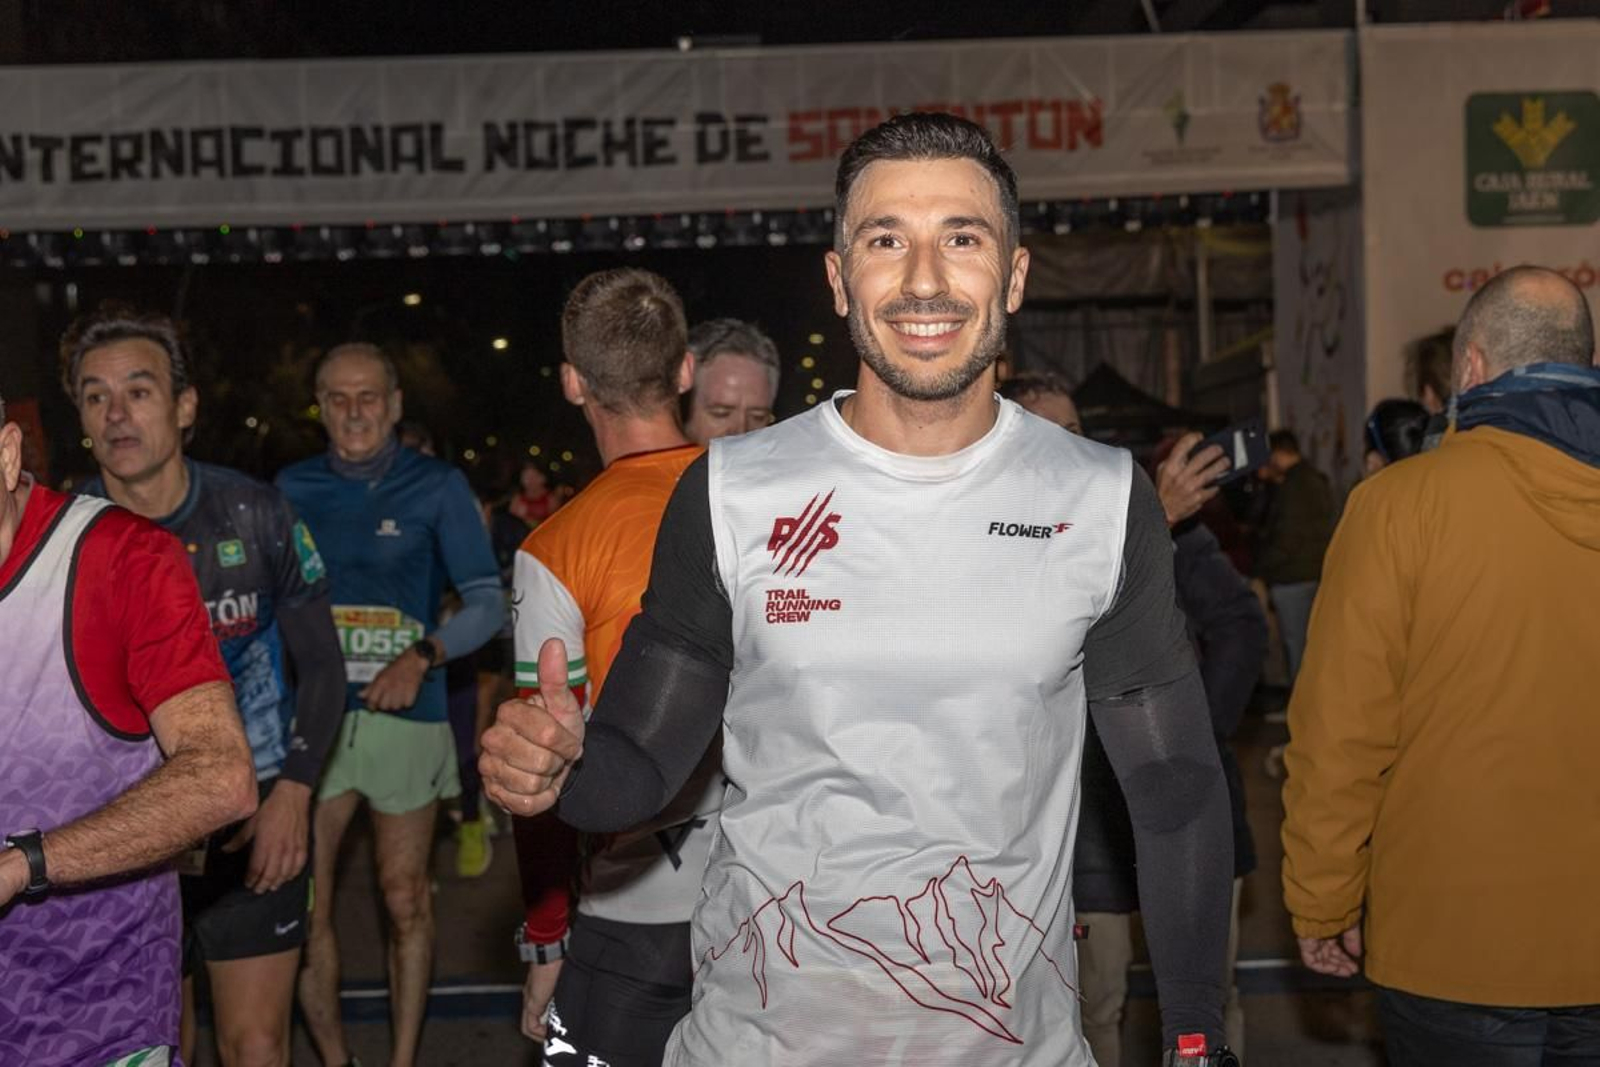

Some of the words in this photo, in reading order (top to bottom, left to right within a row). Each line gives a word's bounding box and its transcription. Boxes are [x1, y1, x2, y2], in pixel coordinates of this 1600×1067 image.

[483, 115, 675, 171] NOCHE
[695, 112, 768, 164] DE
[988, 522, 1052, 539] FLOWER
[765, 589, 810, 601] TRAIL
[765, 599, 841, 613] RUNNING
[766, 611, 811, 623] CREW
